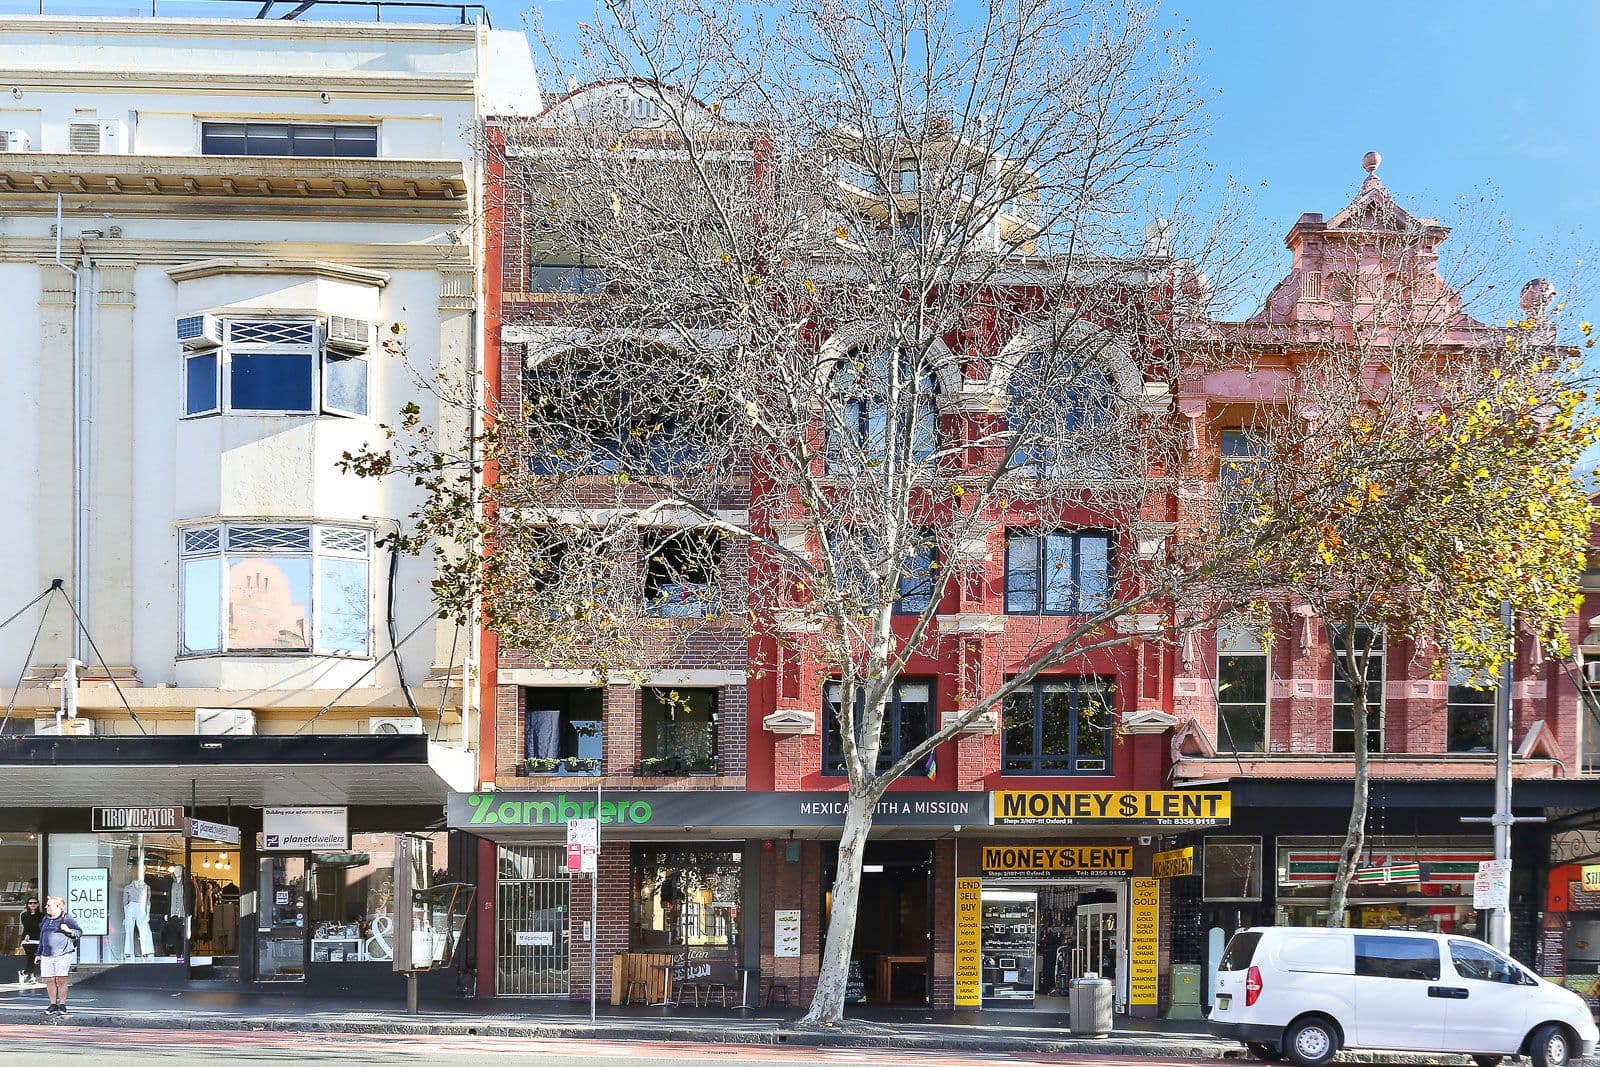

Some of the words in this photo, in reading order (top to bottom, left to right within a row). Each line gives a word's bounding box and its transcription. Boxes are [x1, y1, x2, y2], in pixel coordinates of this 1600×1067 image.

[468, 794, 652, 824] Zambrero
[800, 802, 849, 814] MEXICA
[902, 803, 911, 814] A
[915, 802, 969, 814] MISSION
[283, 835, 345, 845] planetdwellers
[958, 881, 980, 889] LEND
[70, 888, 103, 902] SALE
[960, 892, 978, 900] SELL
[1133, 898, 1157, 906] GOLD
[961, 903, 976, 912] BUY
[71, 908, 105, 919] STORE
